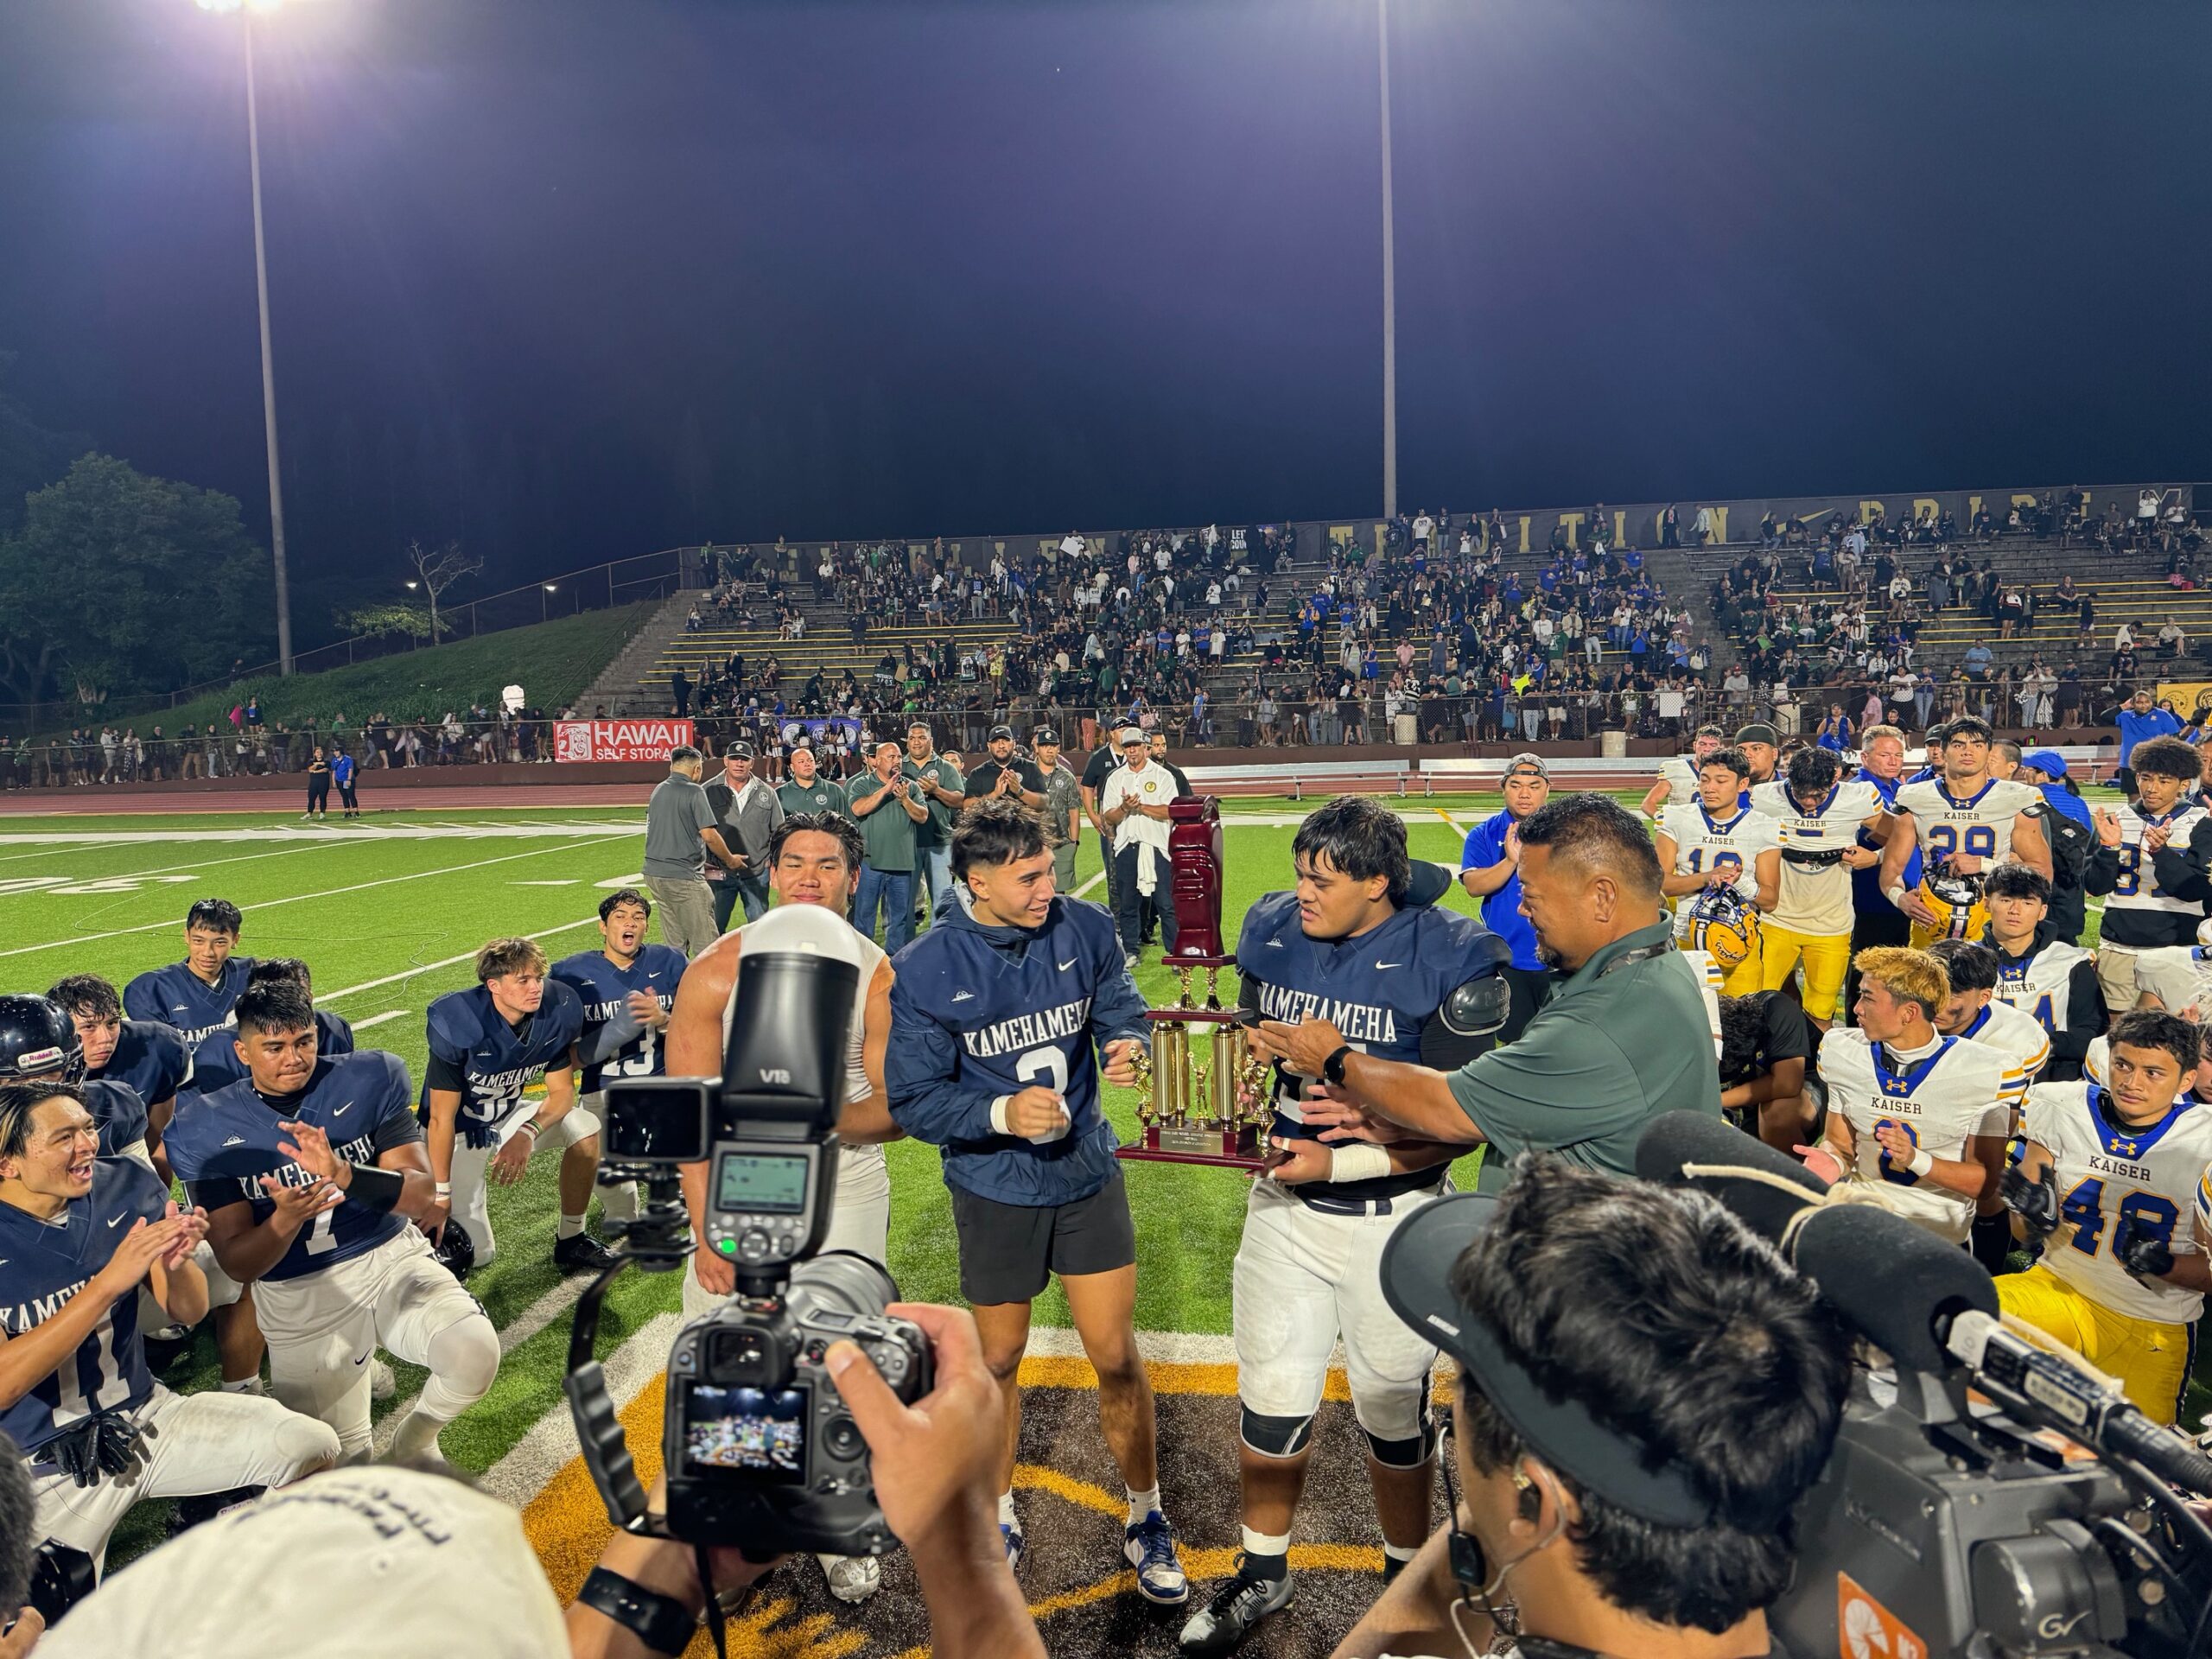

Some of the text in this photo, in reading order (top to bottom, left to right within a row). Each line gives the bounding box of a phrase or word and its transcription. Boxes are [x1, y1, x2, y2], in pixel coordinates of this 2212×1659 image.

[595, 747, 672, 760] SELF STORA
[1944, 811, 1980, 820] KAISER
[1794, 819, 1827, 828] KAISER
[1701, 836, 1735, 846] KAISER
[1928, 823, 1997, 862] 29
[1996, 982, 2037, 993] KAISER
[29, 1051, 54, 1062] Riddell
[1871, 1096, 1923, 1115] KAISER
[2088, 1155, 2152, 1182] KAISER
[2060, 1174, 2183, 1268] 48
